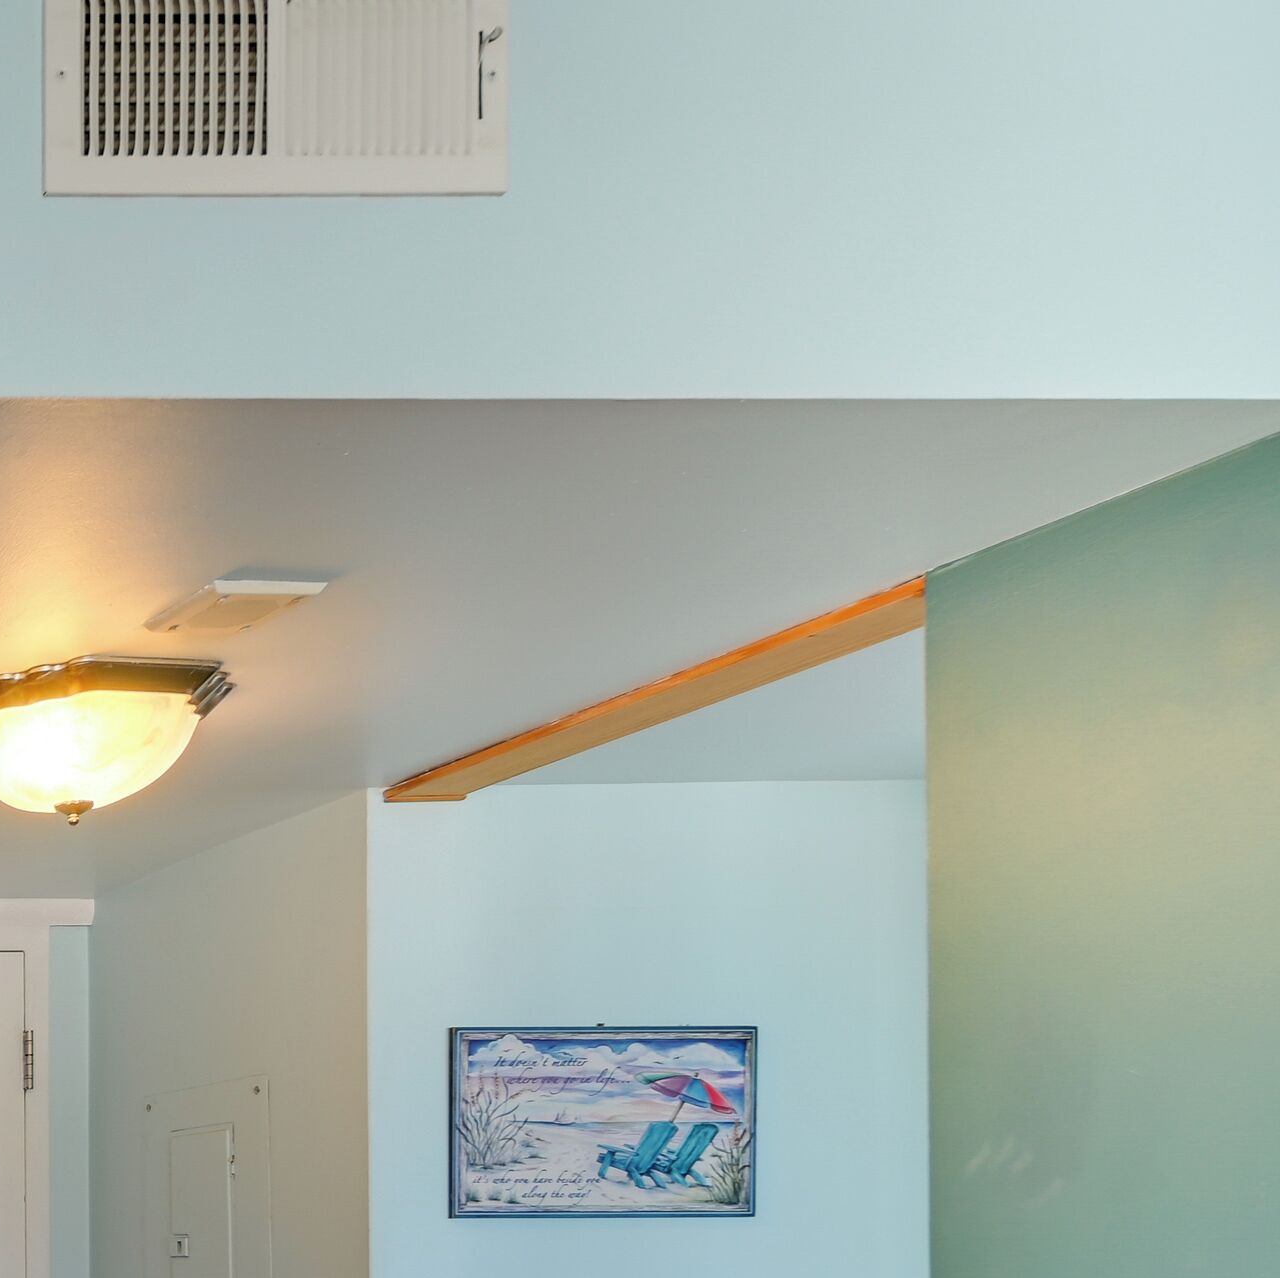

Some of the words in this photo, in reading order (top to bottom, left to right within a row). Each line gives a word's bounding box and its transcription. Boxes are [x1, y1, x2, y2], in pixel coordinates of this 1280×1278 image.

[494, 1056, 508, 1067] It
[509, 1051, 550, 1067] doesn't
[551, 1057, 588, 1067] matter
[506, 1067, 538, 1084] where
[472, 1175, 488, 1184] it's
[492, 1170, 514, 1184] who
[532, 1169, 554, 1184] have
[556, 1170, 586, 1185] beside
[521, 1185, 548, 1207] along
[550, 1184, 568, 1198] the
